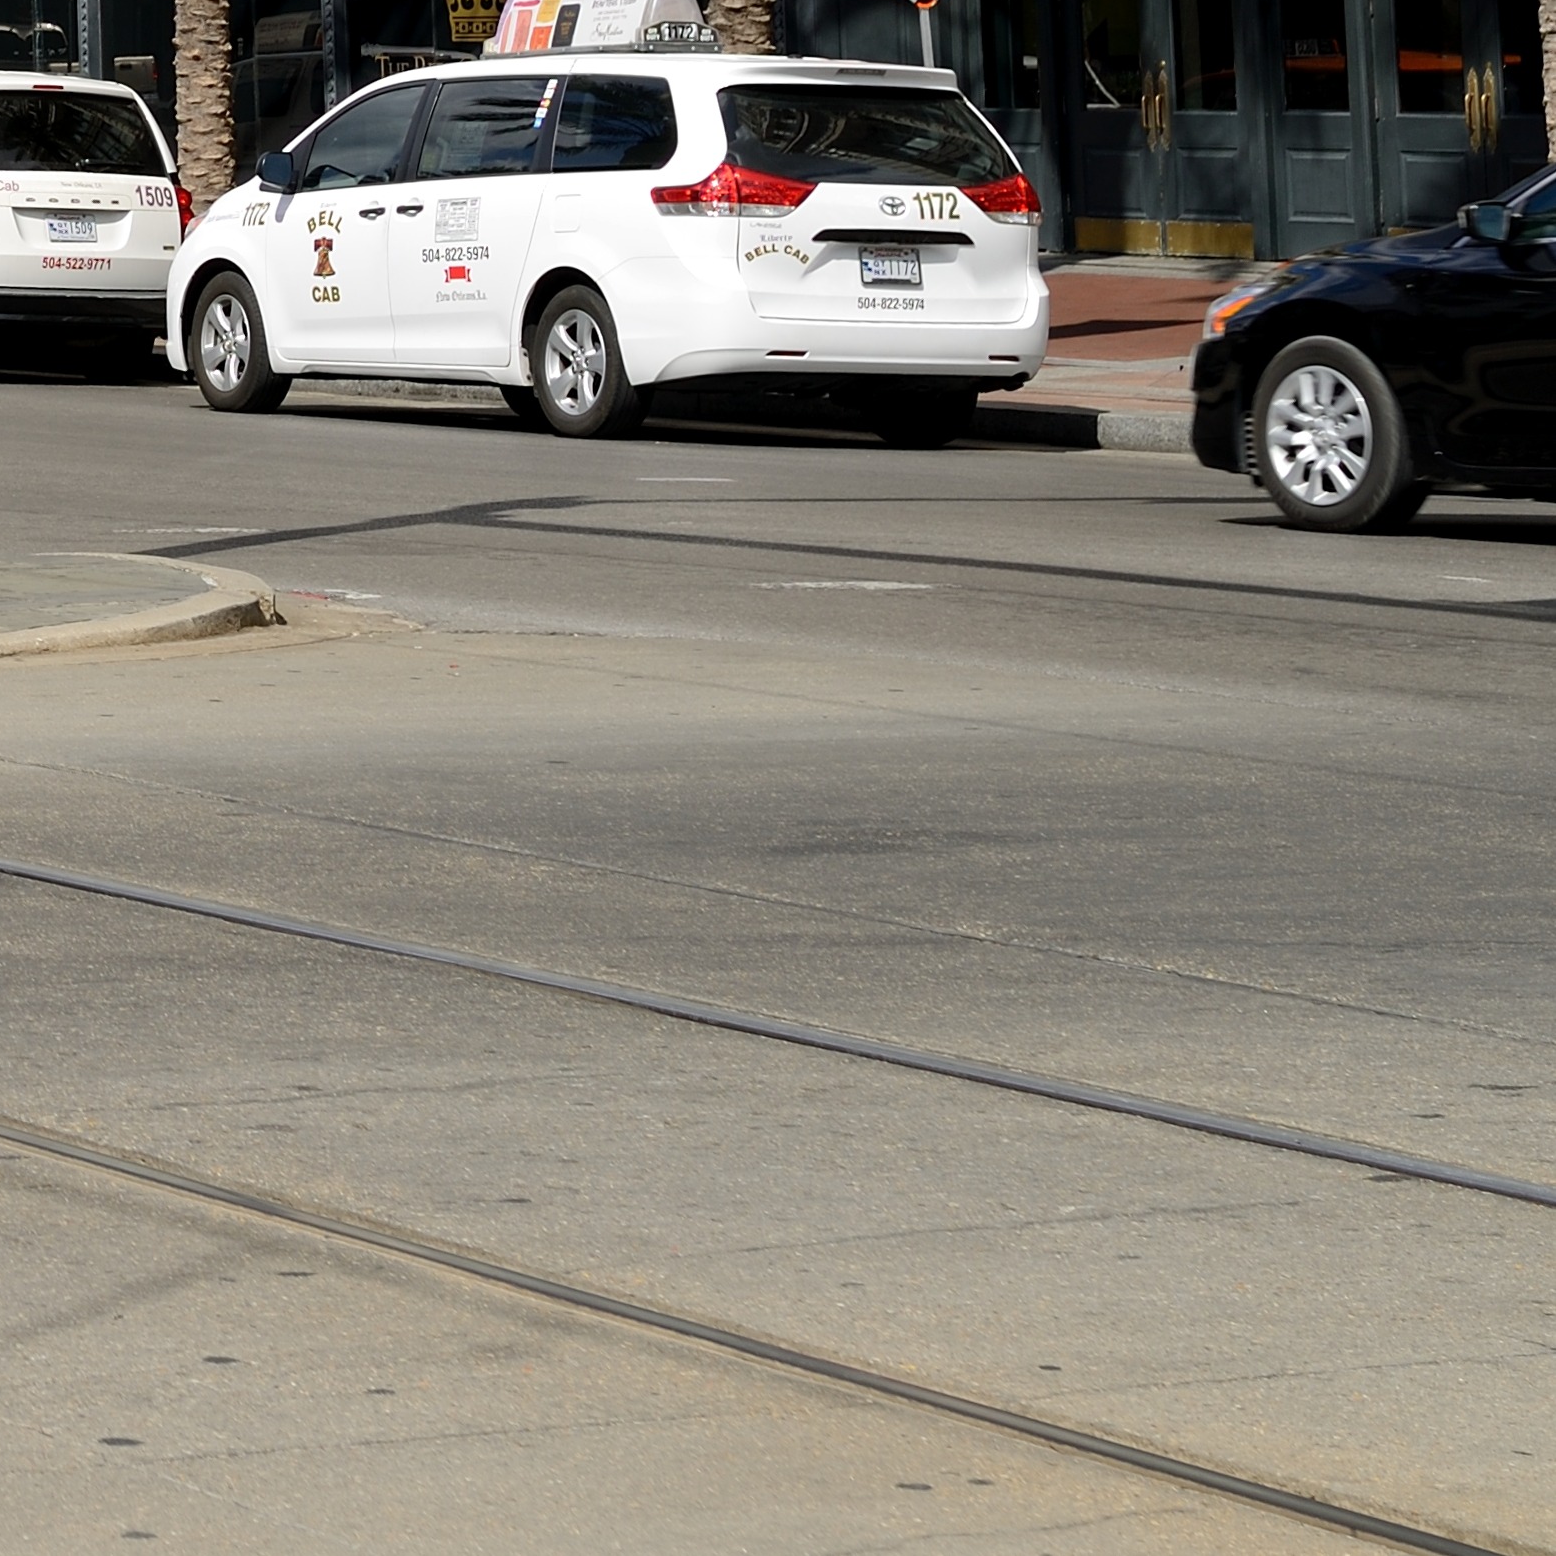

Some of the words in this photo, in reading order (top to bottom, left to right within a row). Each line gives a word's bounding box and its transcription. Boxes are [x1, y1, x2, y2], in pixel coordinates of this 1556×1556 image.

[666, 24, 695, 40] 1172
[135, 185, 174, 207] 1509
[242, 202, 271, 226] 1172
[912, 192, 960, 220] 1172
[70, 222, 93, 235] 1509
[307, 210, 343, 235] BELL
[422, 246, 489, 263] 504-822-5974
[744, 243, 779, 262] BELL
[783, 244, 810, 264] CAB
[42, 256, 112, 270] 504-522-9771
[889, 260, 917, 276] 1172
[312, 286, 341, 302] CAB
[857, 297, 925, 310] 504-822-5974
